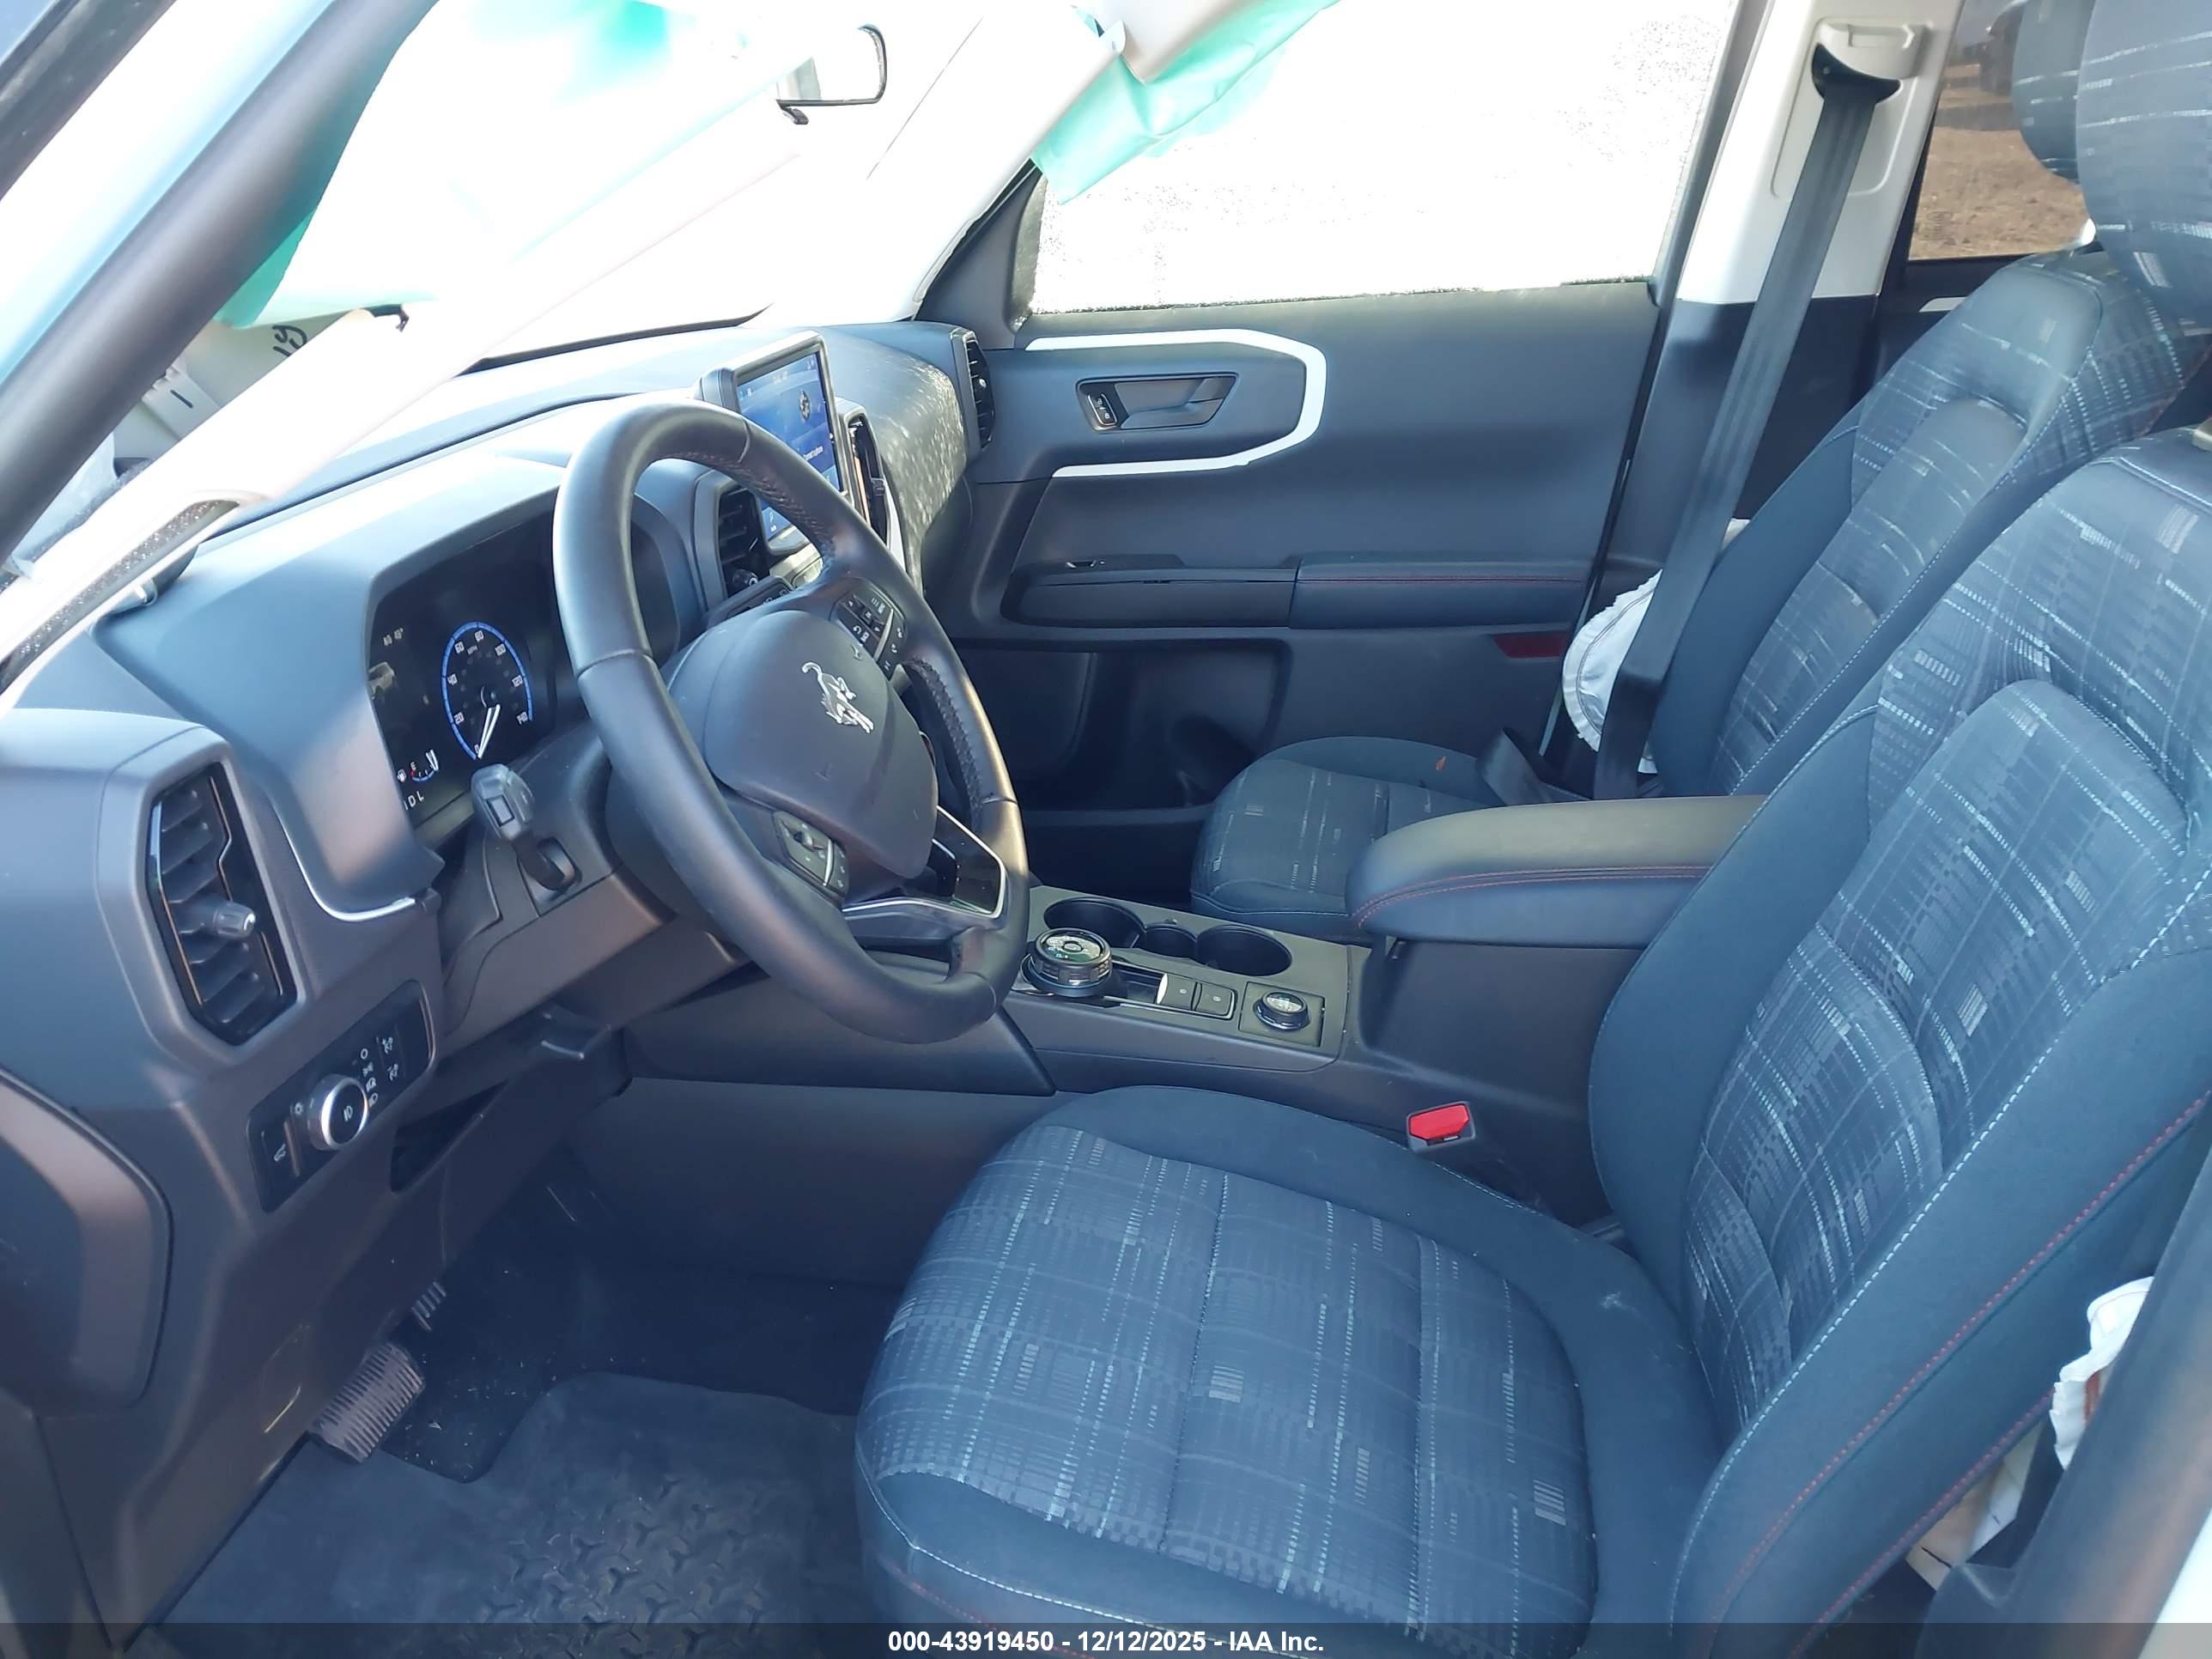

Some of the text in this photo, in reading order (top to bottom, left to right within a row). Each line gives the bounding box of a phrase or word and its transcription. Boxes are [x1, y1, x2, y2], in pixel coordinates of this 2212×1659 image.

[447, 674, 458, 686] 40
[512, 675, 524, 688] 120
[453, 712, 465, 726] 20
[517, 711, 528, 725] 140
[410, 762, 417, 770] E
